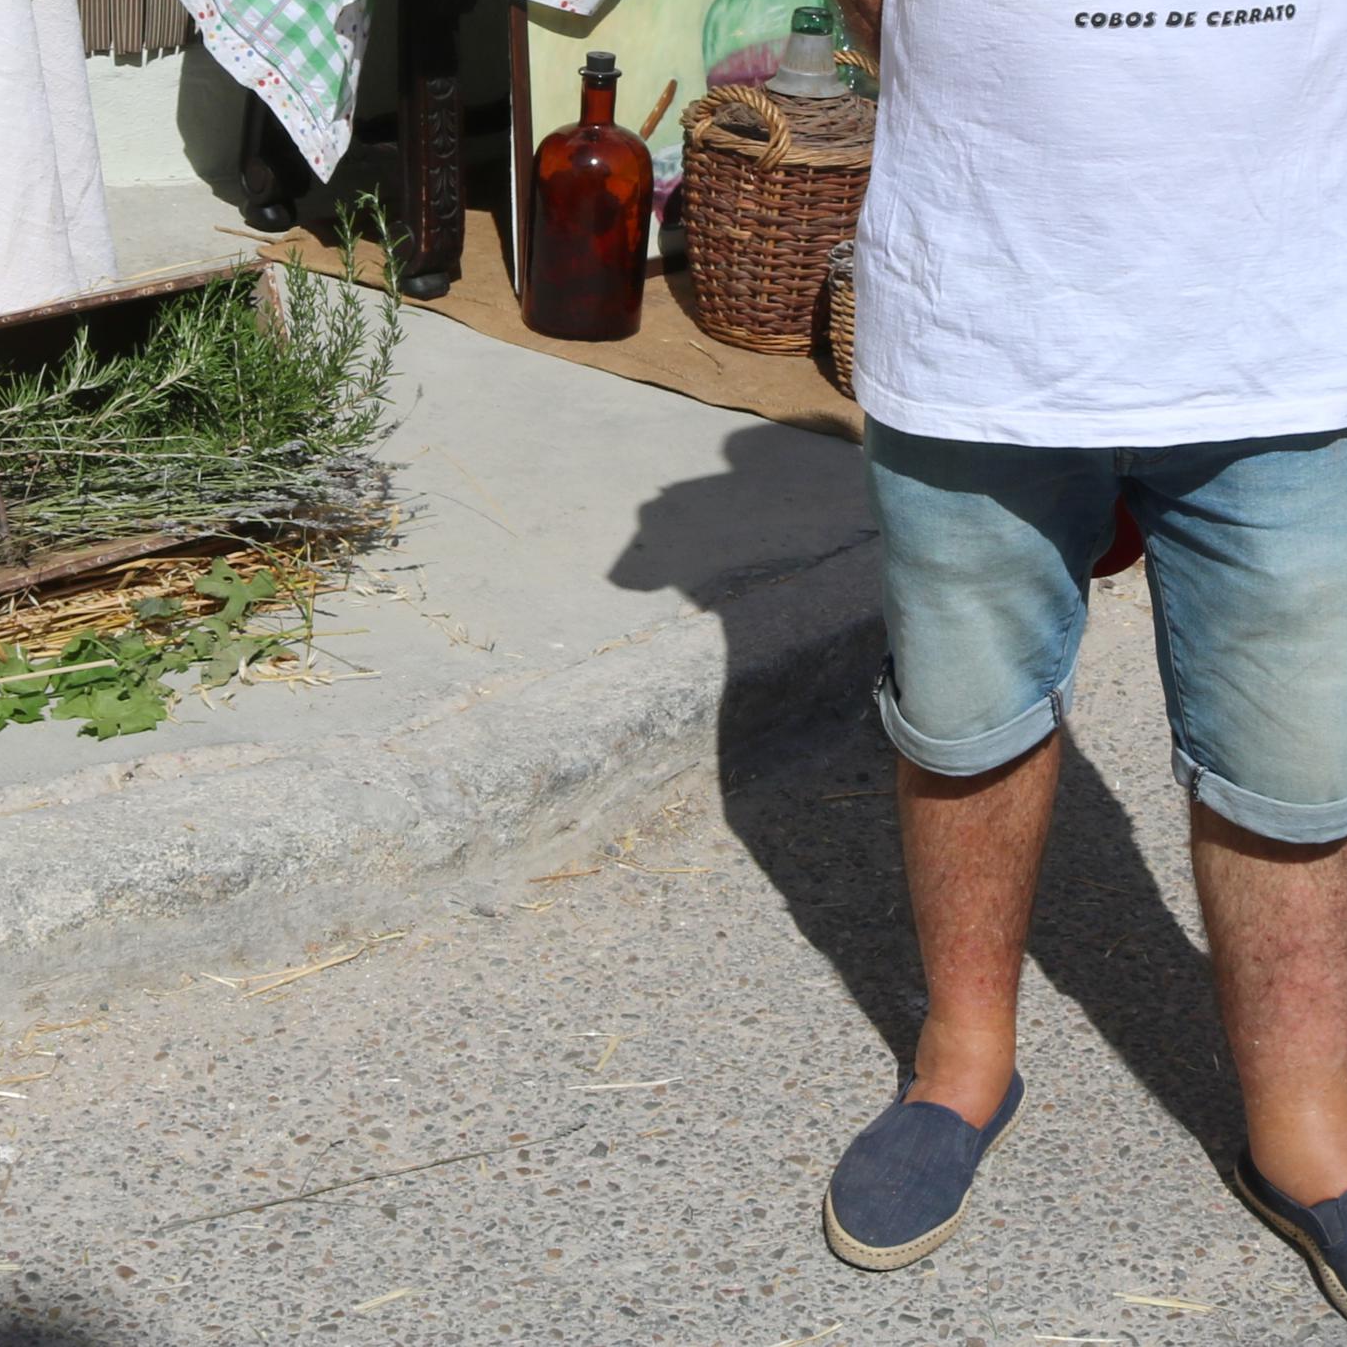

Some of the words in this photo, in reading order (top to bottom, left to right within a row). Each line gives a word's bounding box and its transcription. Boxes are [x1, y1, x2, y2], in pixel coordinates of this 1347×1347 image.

[1074, 11, 1156, 28] COBOS
[1165, 11, 1197, 28] DE
[1206, 3, 1296, 28] CERRATO
